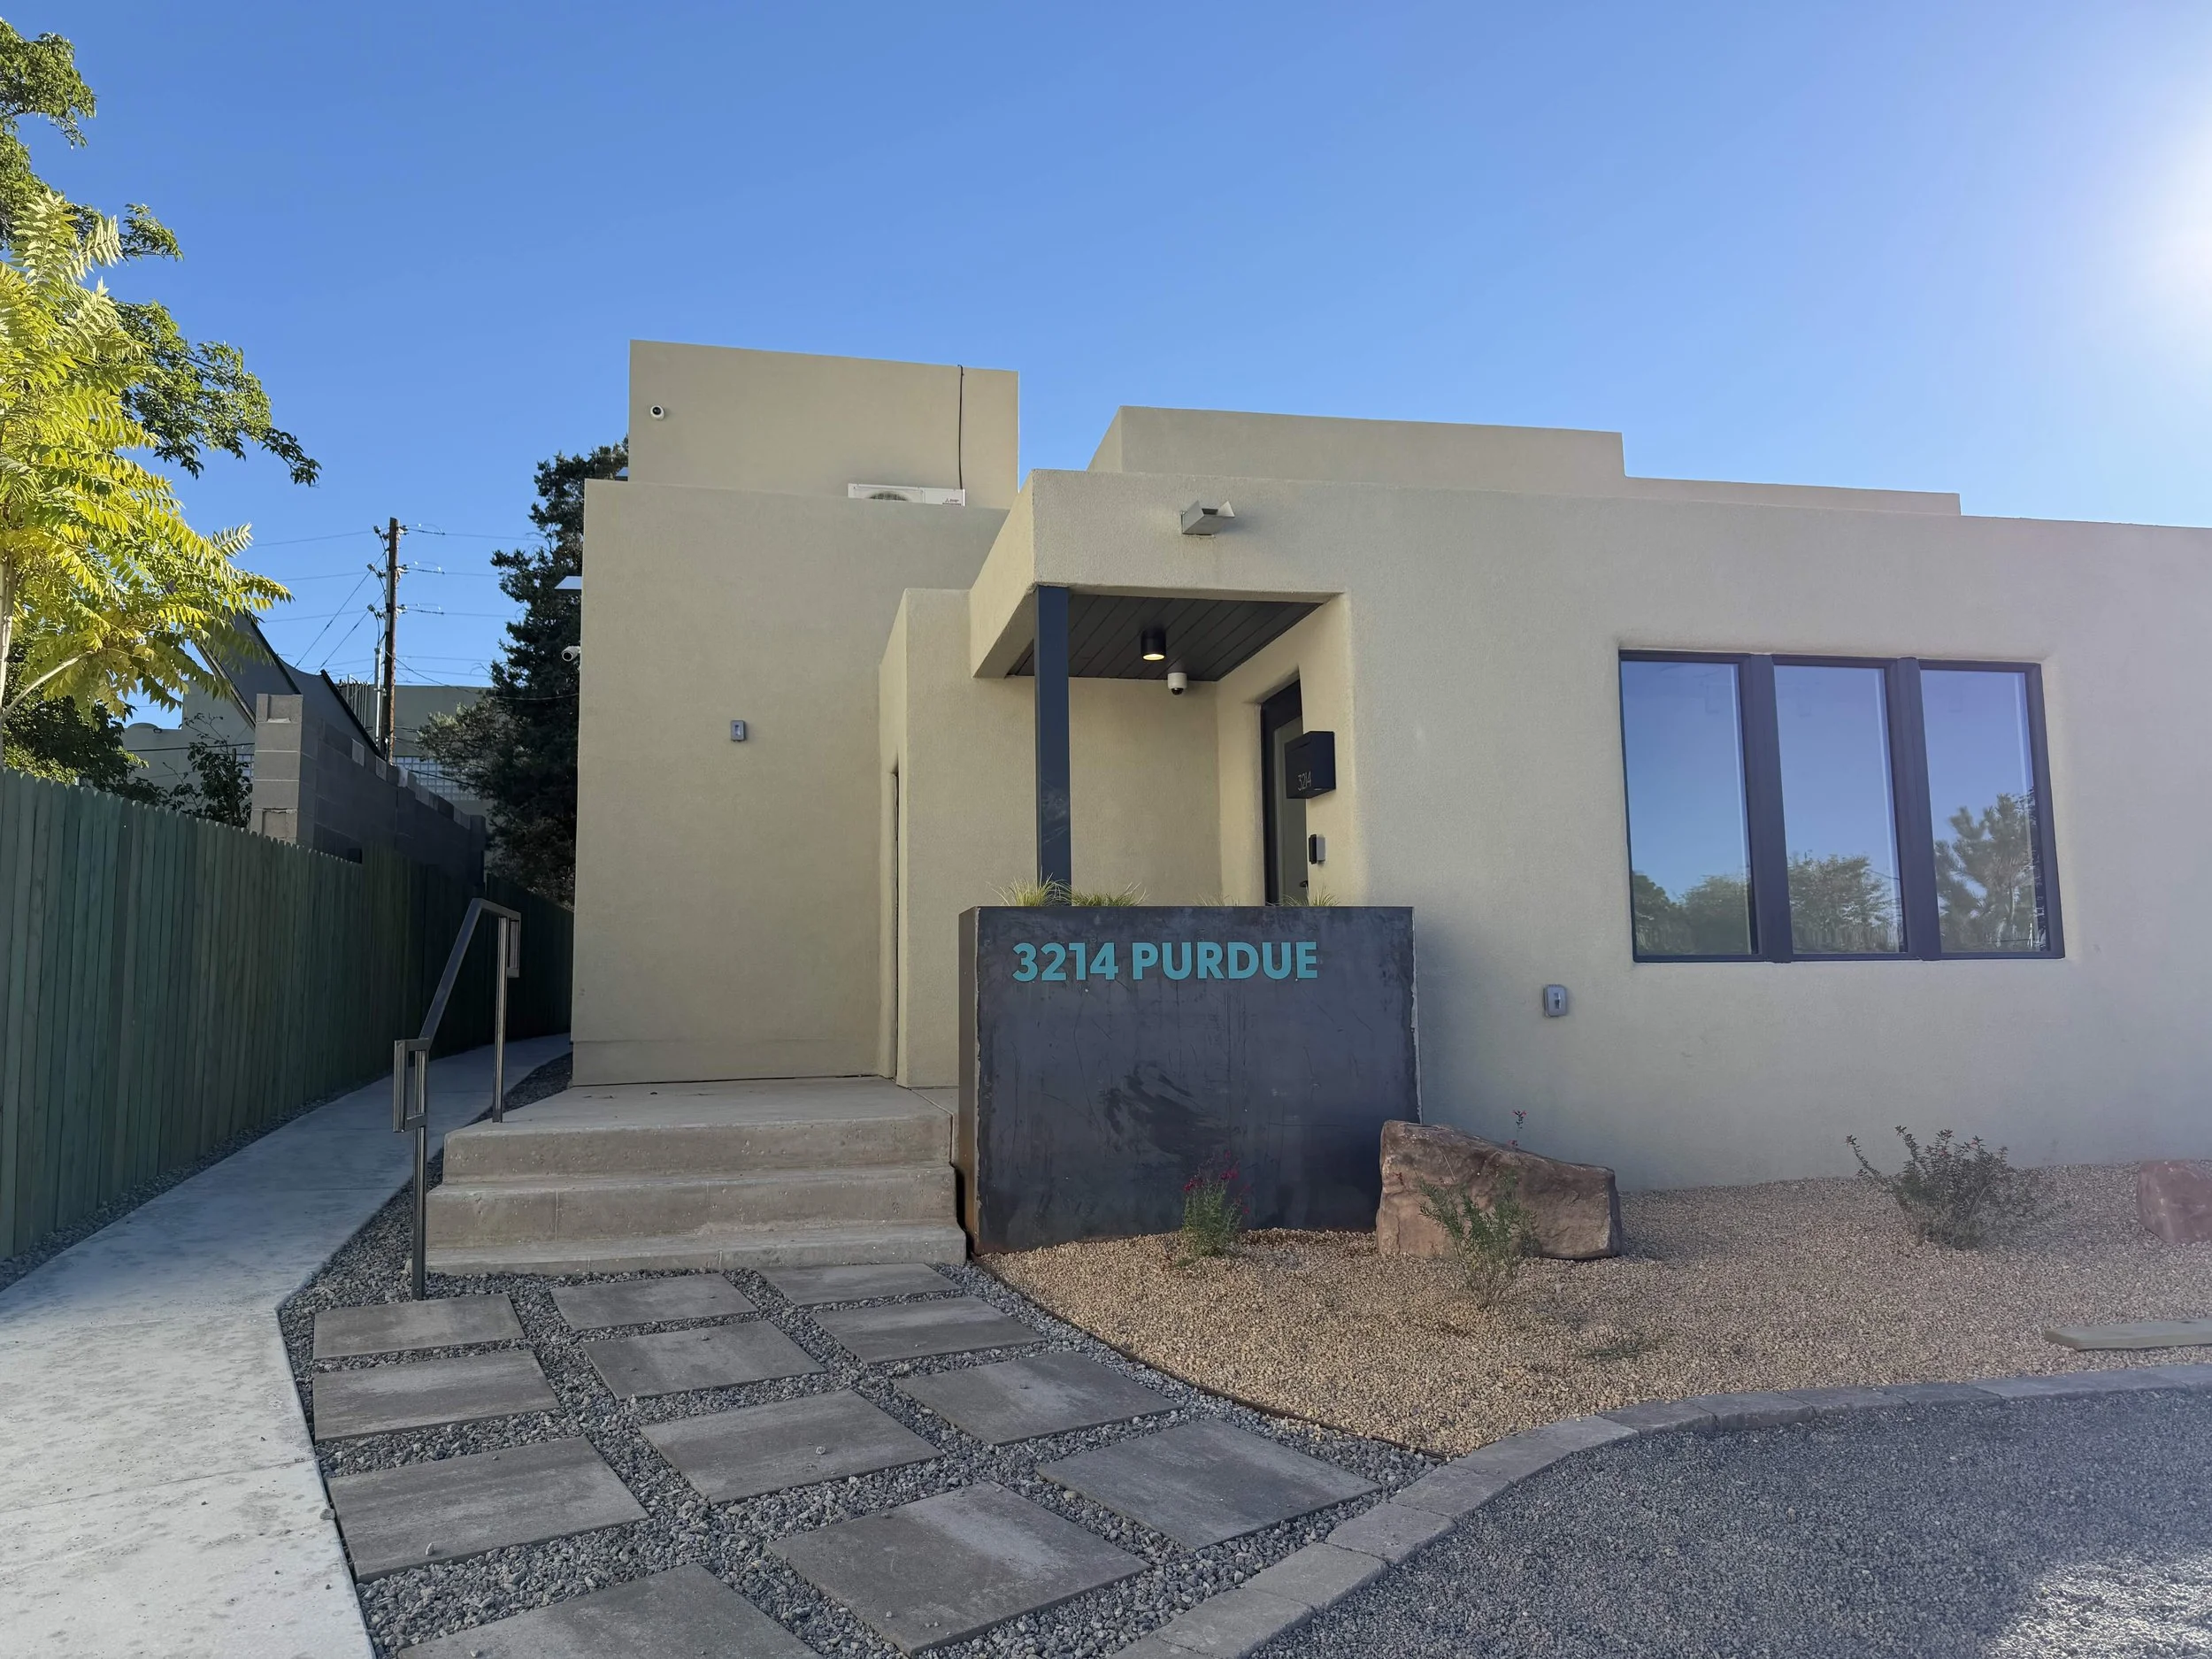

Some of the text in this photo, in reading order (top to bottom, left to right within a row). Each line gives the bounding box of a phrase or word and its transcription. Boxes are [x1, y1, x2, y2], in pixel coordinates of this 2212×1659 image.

[1297, 771, 1311, 791] 3214
[1012, 941, 1318, 982] 3214 PURDUE
